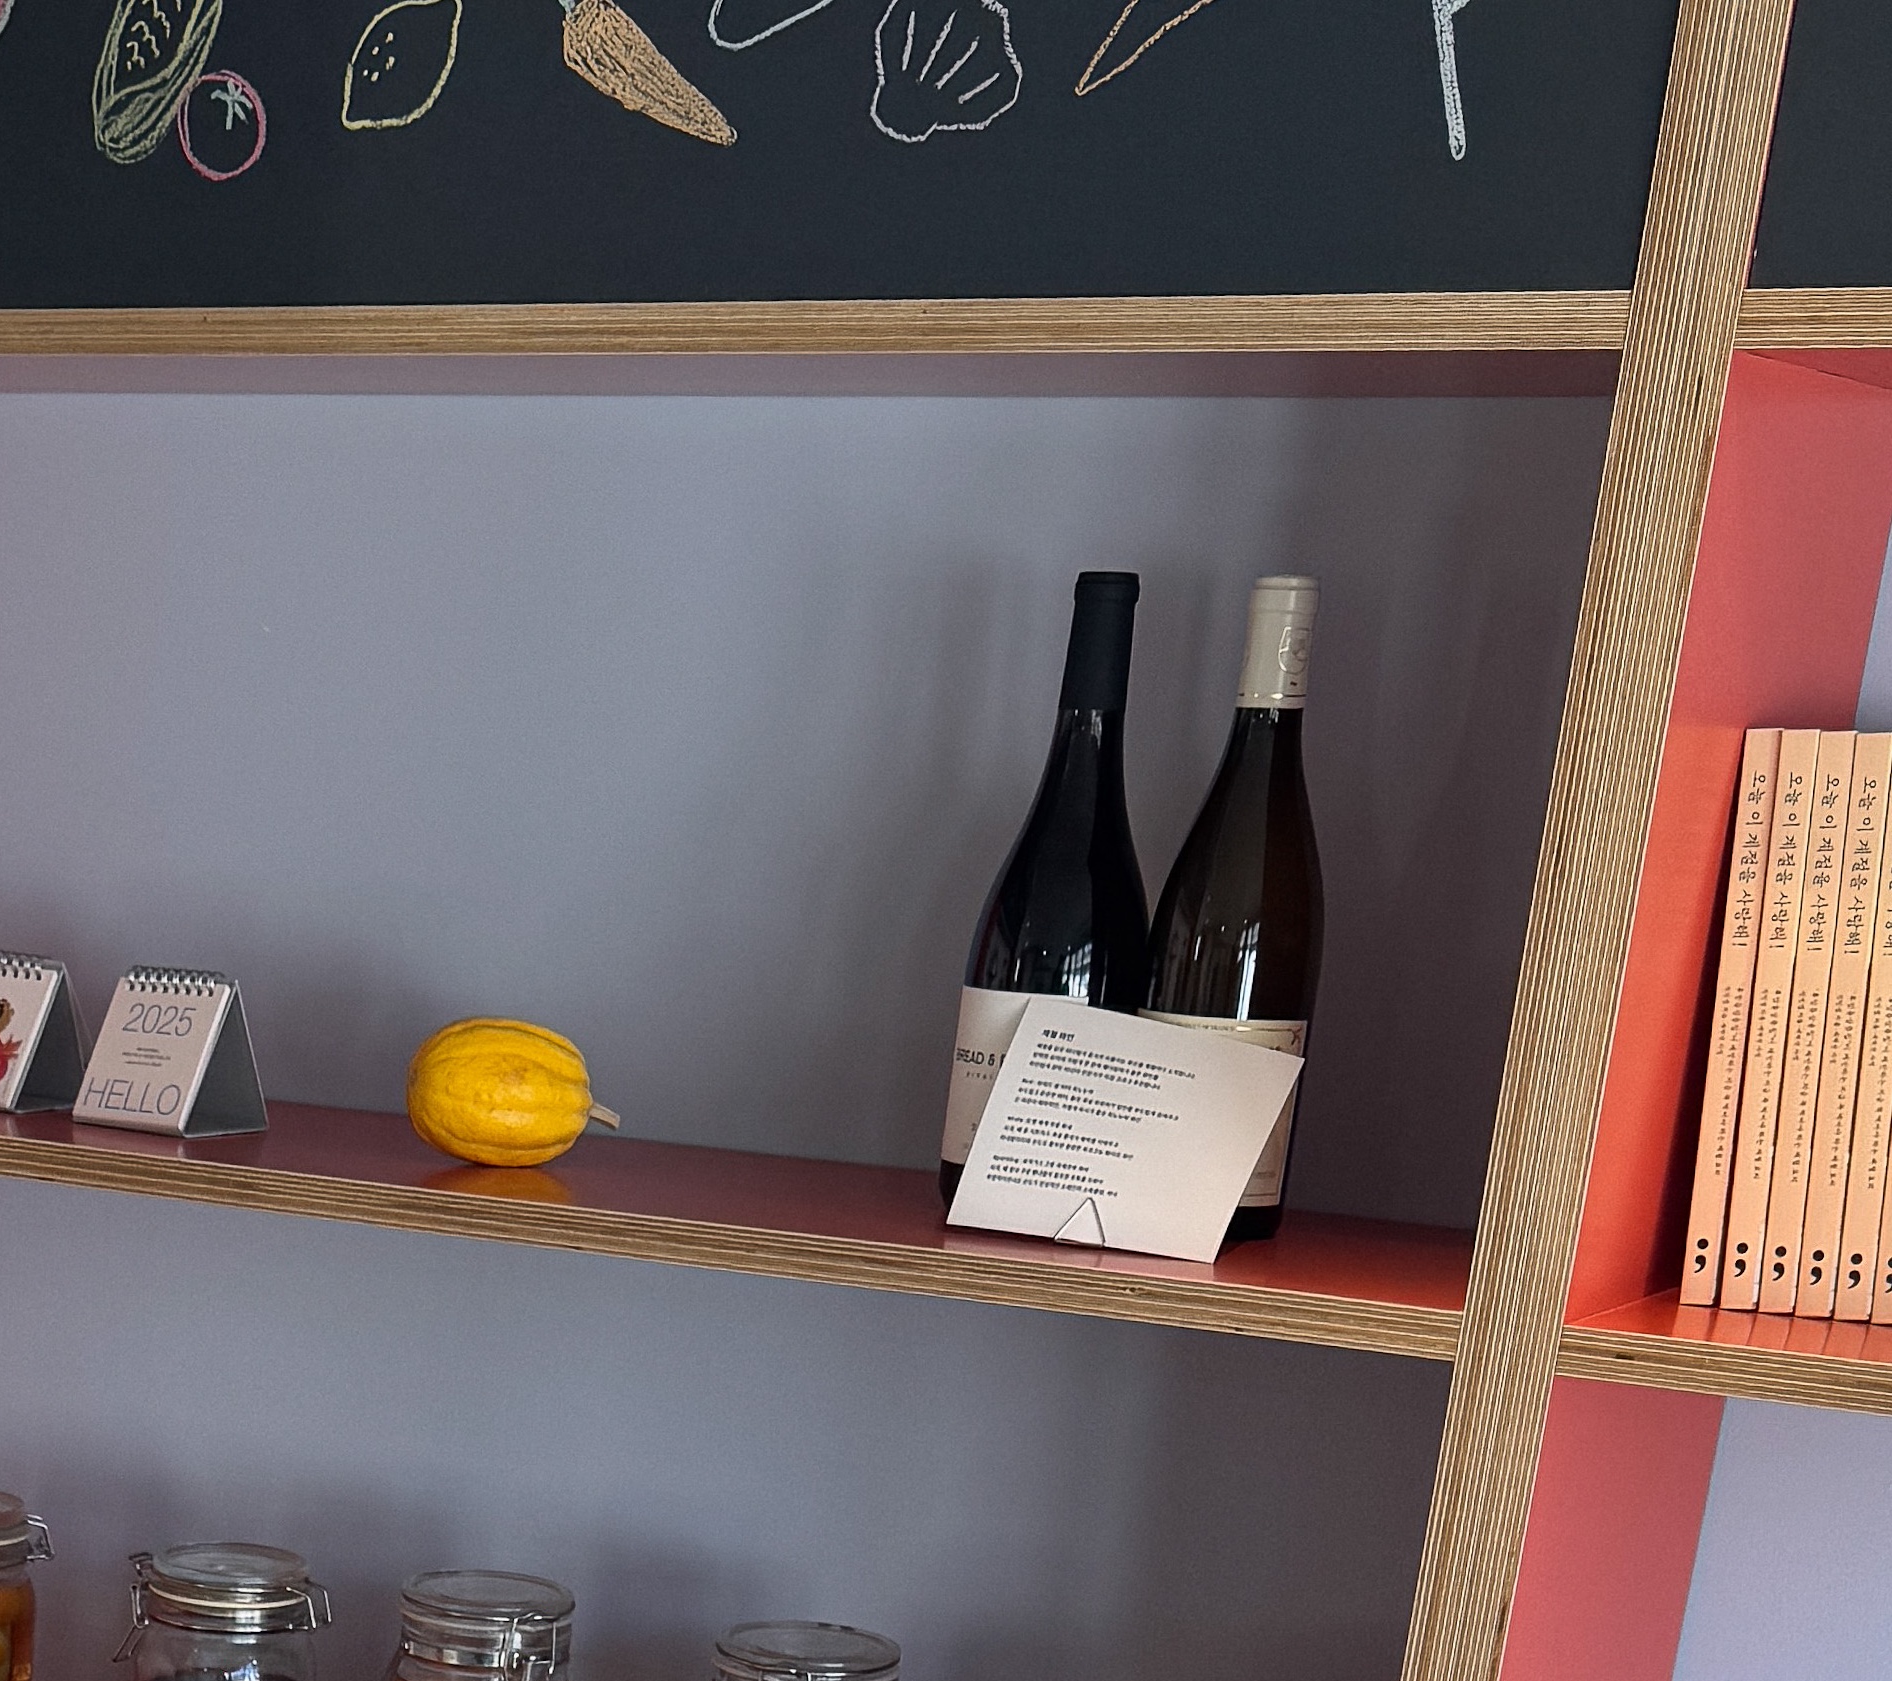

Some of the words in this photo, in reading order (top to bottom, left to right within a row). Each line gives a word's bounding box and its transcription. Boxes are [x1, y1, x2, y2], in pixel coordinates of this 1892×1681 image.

[1745, 811, 1764, 825] 이
[1781, 812, 1800, 827] 이
[1819, 814, 1837, 829] 이
[1856, 817, 1875, 831] 이
[122, 1002, 197, 1037] 2025
[83, 1077, 182, 1116] HELLO
